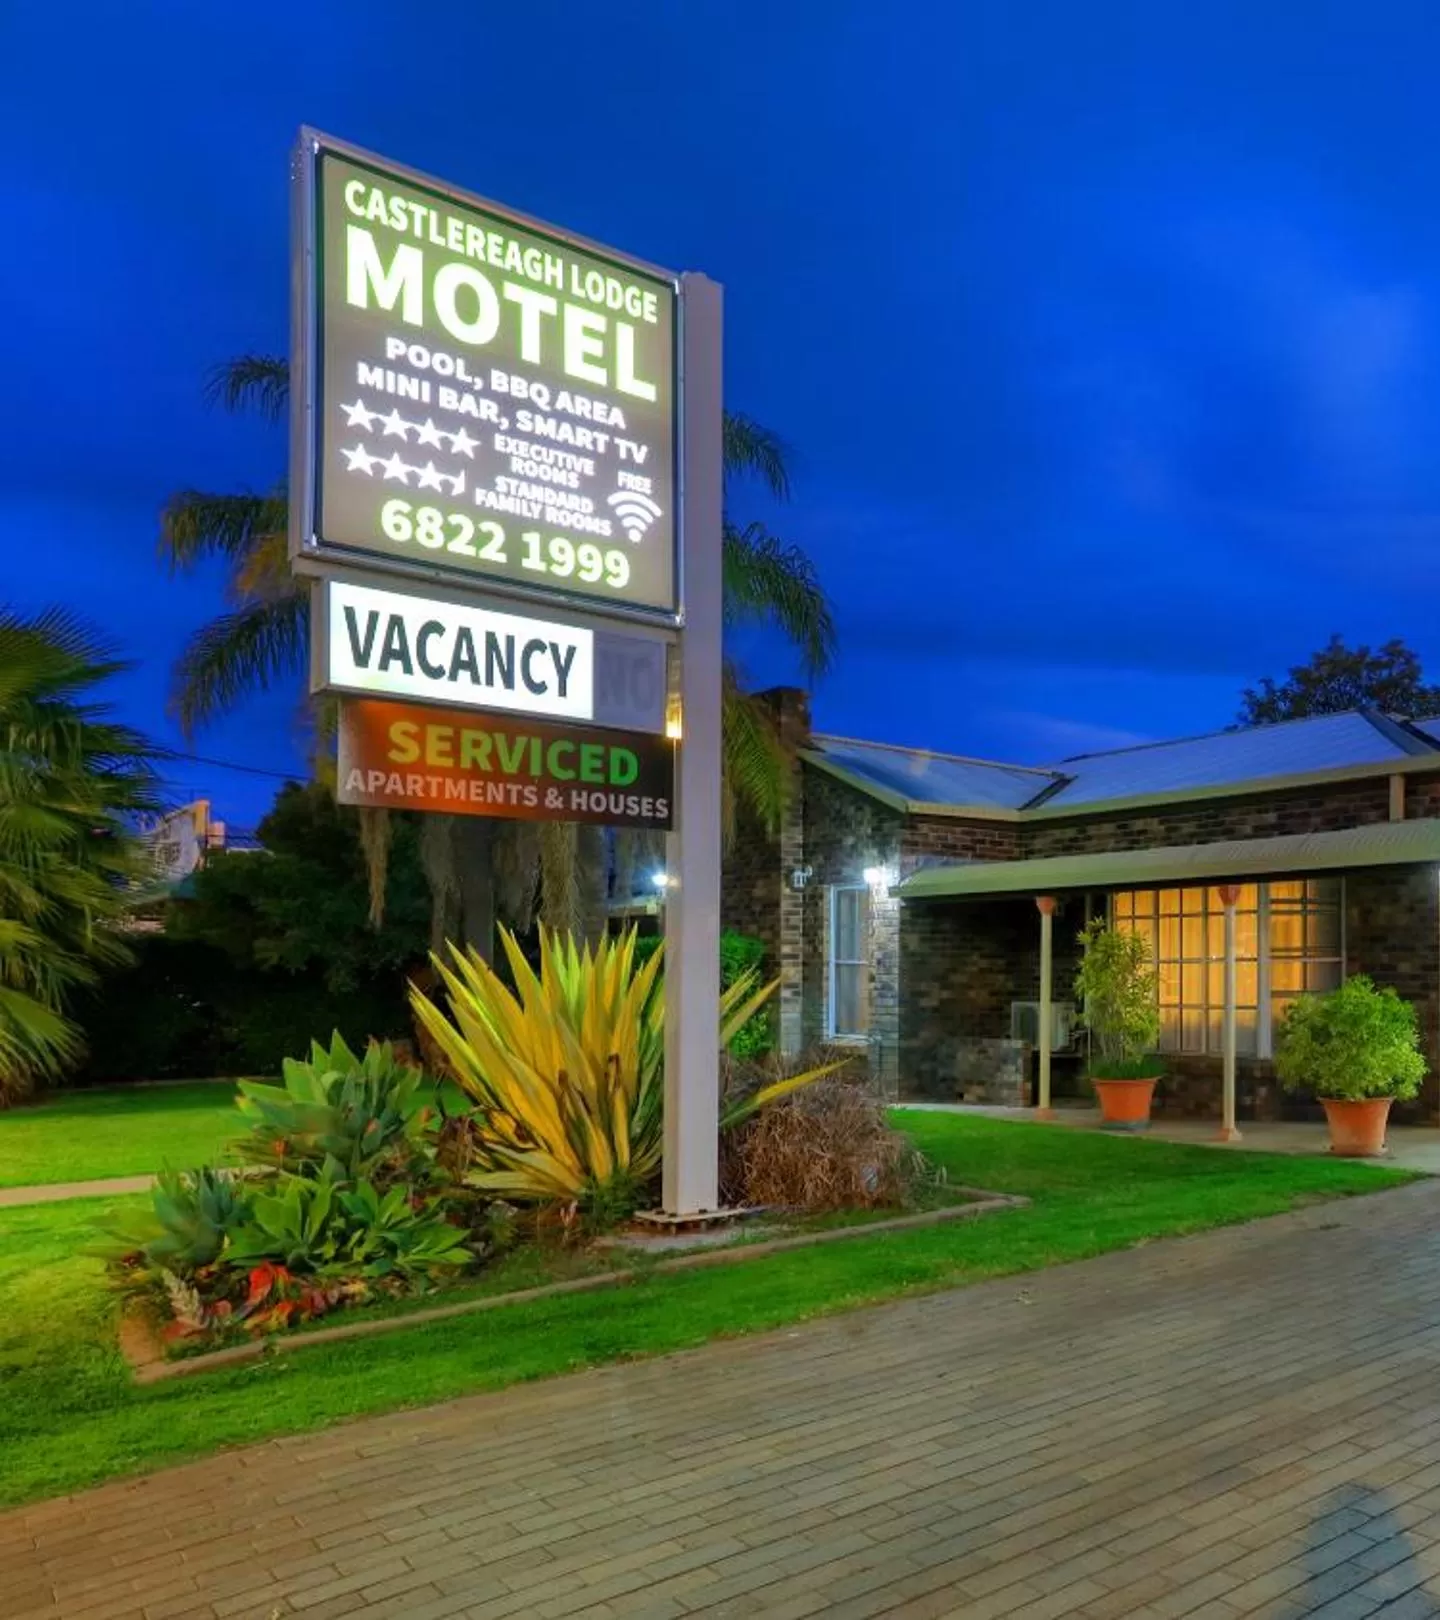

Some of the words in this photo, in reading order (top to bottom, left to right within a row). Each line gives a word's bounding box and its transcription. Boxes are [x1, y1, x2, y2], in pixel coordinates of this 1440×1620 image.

[345, 180, 563, 288] CASTLEREAGH
[571, 263, 657, 324] LODGE
[347, 224, 656, 402] MOTEL
[357, 362, 430, 403] MINI
[439, 386, 509, 430] BAR,
[516, 410, 609, 454] SMART
[614, 437, 648, 465] TV
[386, 337, 484, 390] POOL,
[490, 369, 551, 410] BBQ
[555, 391, 626, 429] AREA
[494, 433, 594, 476] EXECUTIVE
[511, 456, 580, 489] ROOMS
[617, 471, 652, 495] FREE
[475, 487, 542, 519] FAMILY
[546, 506, 612, 537] ROOMS
[495, 476, 593, 514] STANDARD
[381, 498, 507, 564] 6822
[522, 531, 631, 588] 1999
[343, 605, 577, 698] VACANCY
[387, 721, 640, 787] SERVICED
[345, 768, 538, 809] APARTMENTS
[545, 789, 564, 810] &
[571, 790, 668, 819] HOUSES
